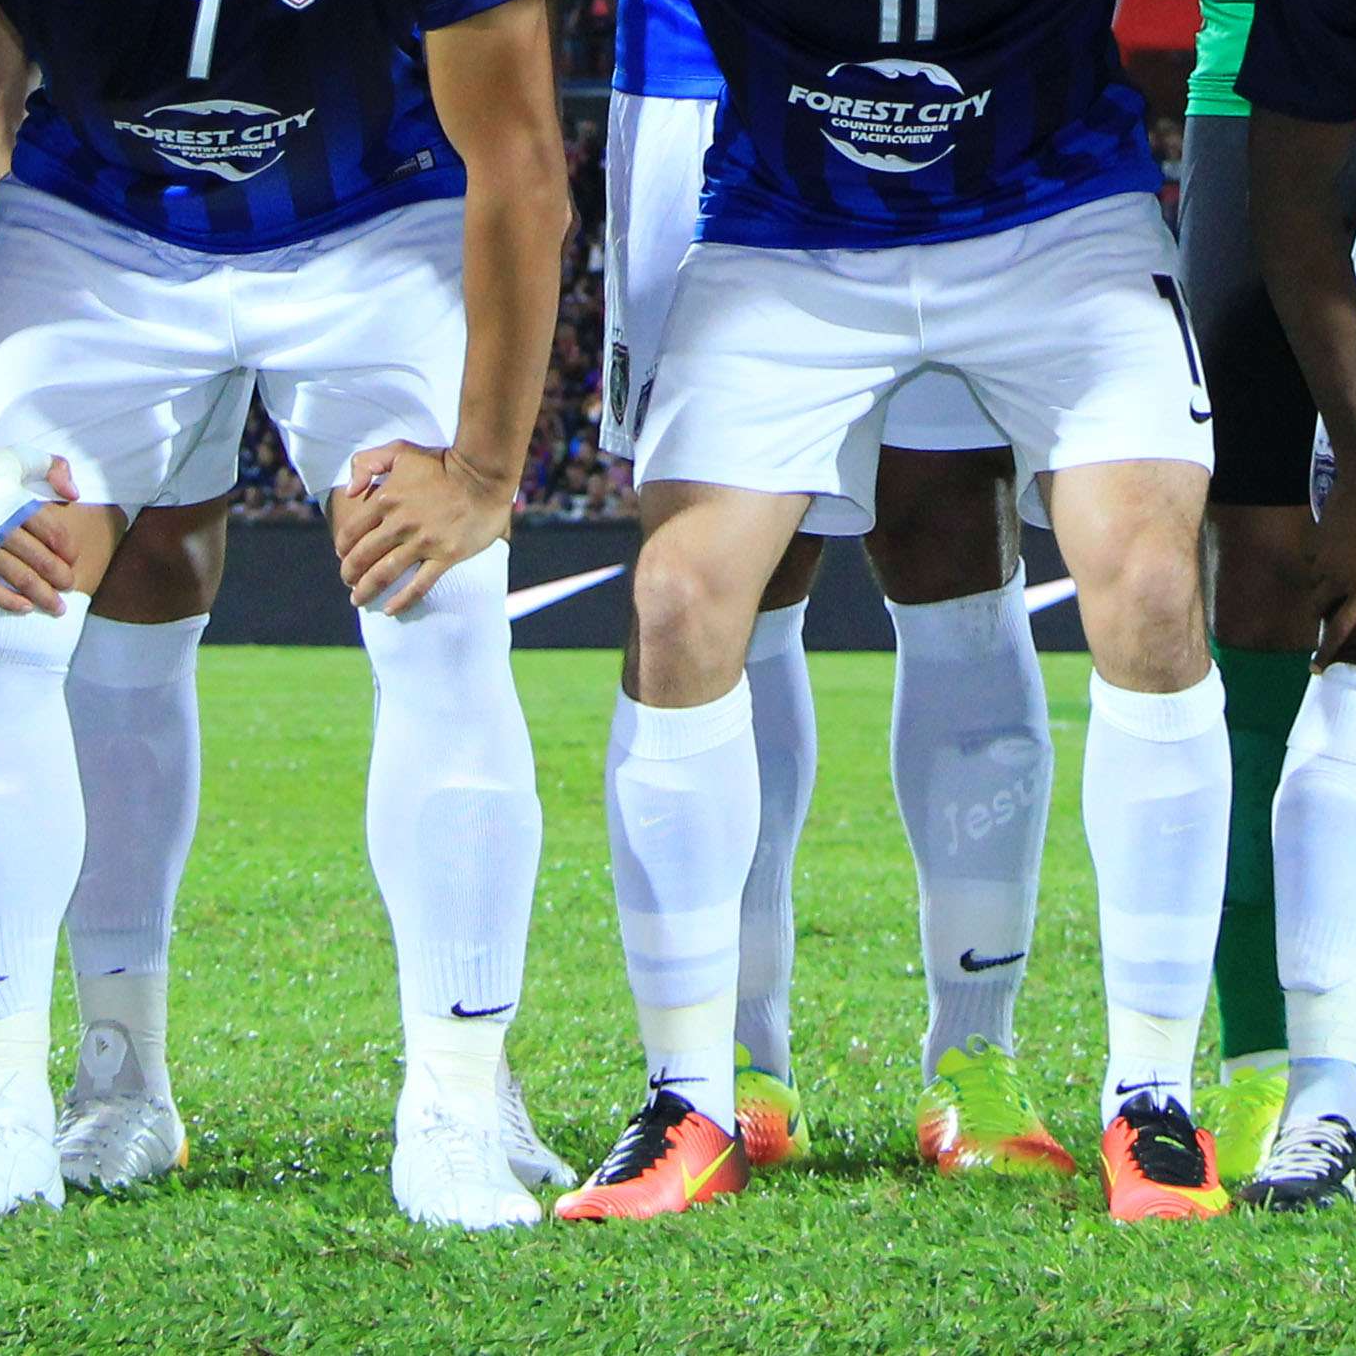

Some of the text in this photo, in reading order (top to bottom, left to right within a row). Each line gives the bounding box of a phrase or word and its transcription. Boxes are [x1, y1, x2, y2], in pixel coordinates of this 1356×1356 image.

[787, 84, 993, 124] FOREST CITY
[113, 107, 316, 145] FOREST CITY
[830, 117, 949, 134] COUNTRY GARDEN
[850, 131, 934, 145] PACIFICVIEW
